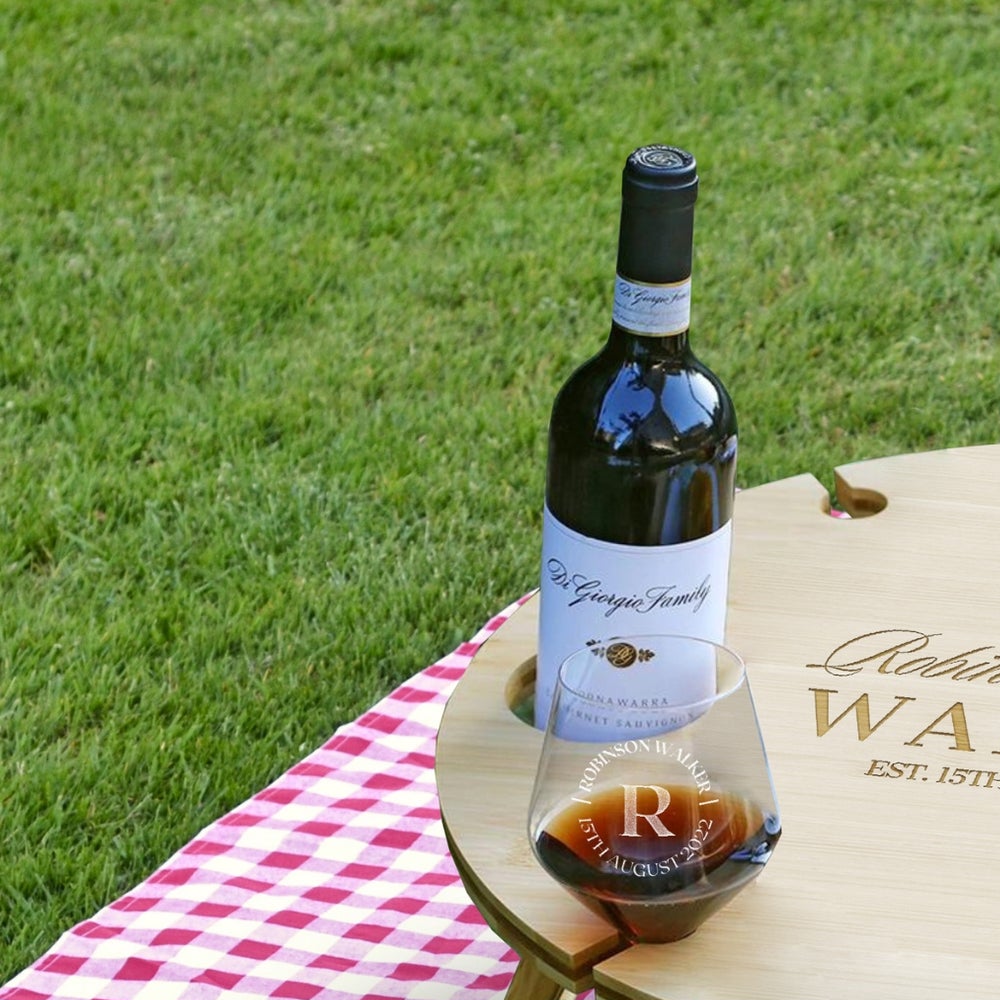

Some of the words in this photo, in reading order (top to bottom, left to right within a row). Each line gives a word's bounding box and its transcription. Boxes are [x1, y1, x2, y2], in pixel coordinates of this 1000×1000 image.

[547, 558, 572, 590] Di
[568, 574, 644, 618] Giorgio
[636, 574, 711, 613] Family
[579, 739, 651, 793] ROBINSON
[655, 740, 711, 794] WALKER
[865, 758, 929, 782] EST.
[618, 784, 676, 838] R
[578, 817, 609, 857] 15TH
[606, 854, 679, 877] AUGUST
[680, 819, 713, 861] 2022
